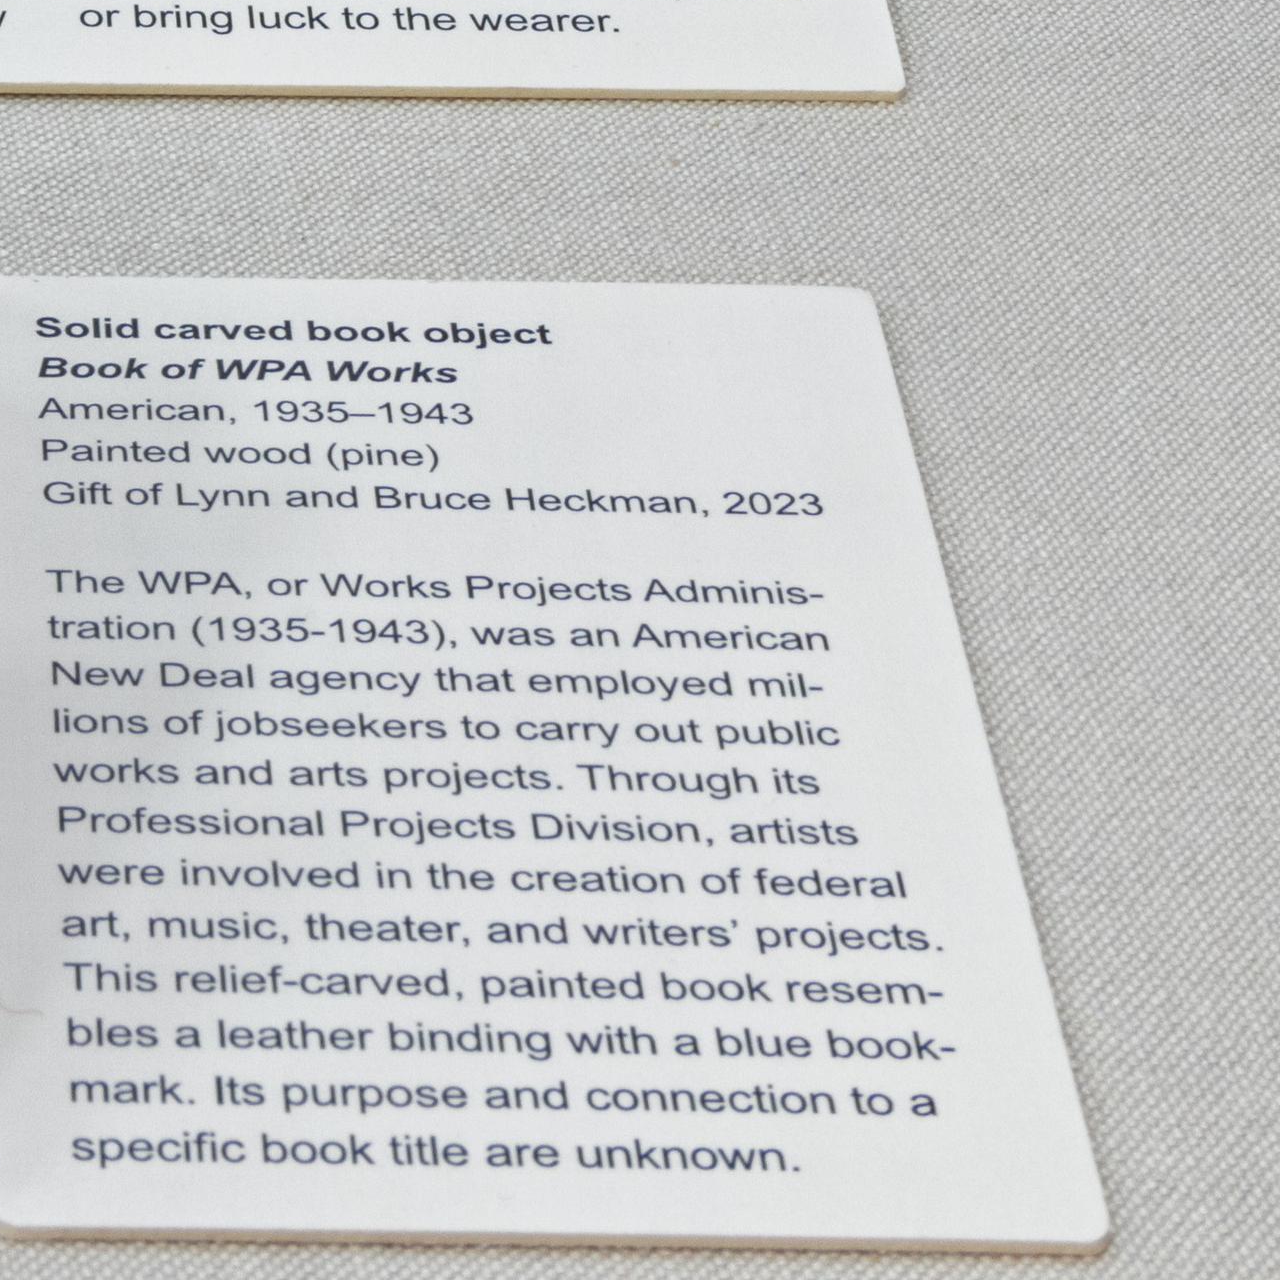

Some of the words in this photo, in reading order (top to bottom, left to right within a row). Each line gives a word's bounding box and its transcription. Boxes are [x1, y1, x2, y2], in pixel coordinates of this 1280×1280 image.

[35, 316, 140, 339] Solid
[154, 319, 293, 341] carved
[307, 320, 411, 343] book
[423, 322, 553, 350] object
[38, 356, 148, 380] Book
[160, 358, 206, 380] of
[215, 358, 312, 382] WPA
[326, 360, 458, 384] Works
[37, 397, 236, 426] American,
[41, 438, 191, 464] Painted
[203, 442, 312, 465] wood
[326, 442, 439, 473] (pine)
[42, 480, 113, 506] Gift
[124, 481, 164, 506] of
[175, 482, 271, 513] Lynn
[285, 485, 359, 509] and
[373, 485, 491, 511] Bruce
[505, 487, 709, 518] Heckman,
[722, 491, 824, 516] 2023
[44, 568, 125, 595] The
[137, 570, 252, 600] WPA,
[267, 577, 309, 597] or
[319, 572, 452, 599] Works
[465, 575, 633, 607] Projects
[643, 578, 824, 605] Adminis-
